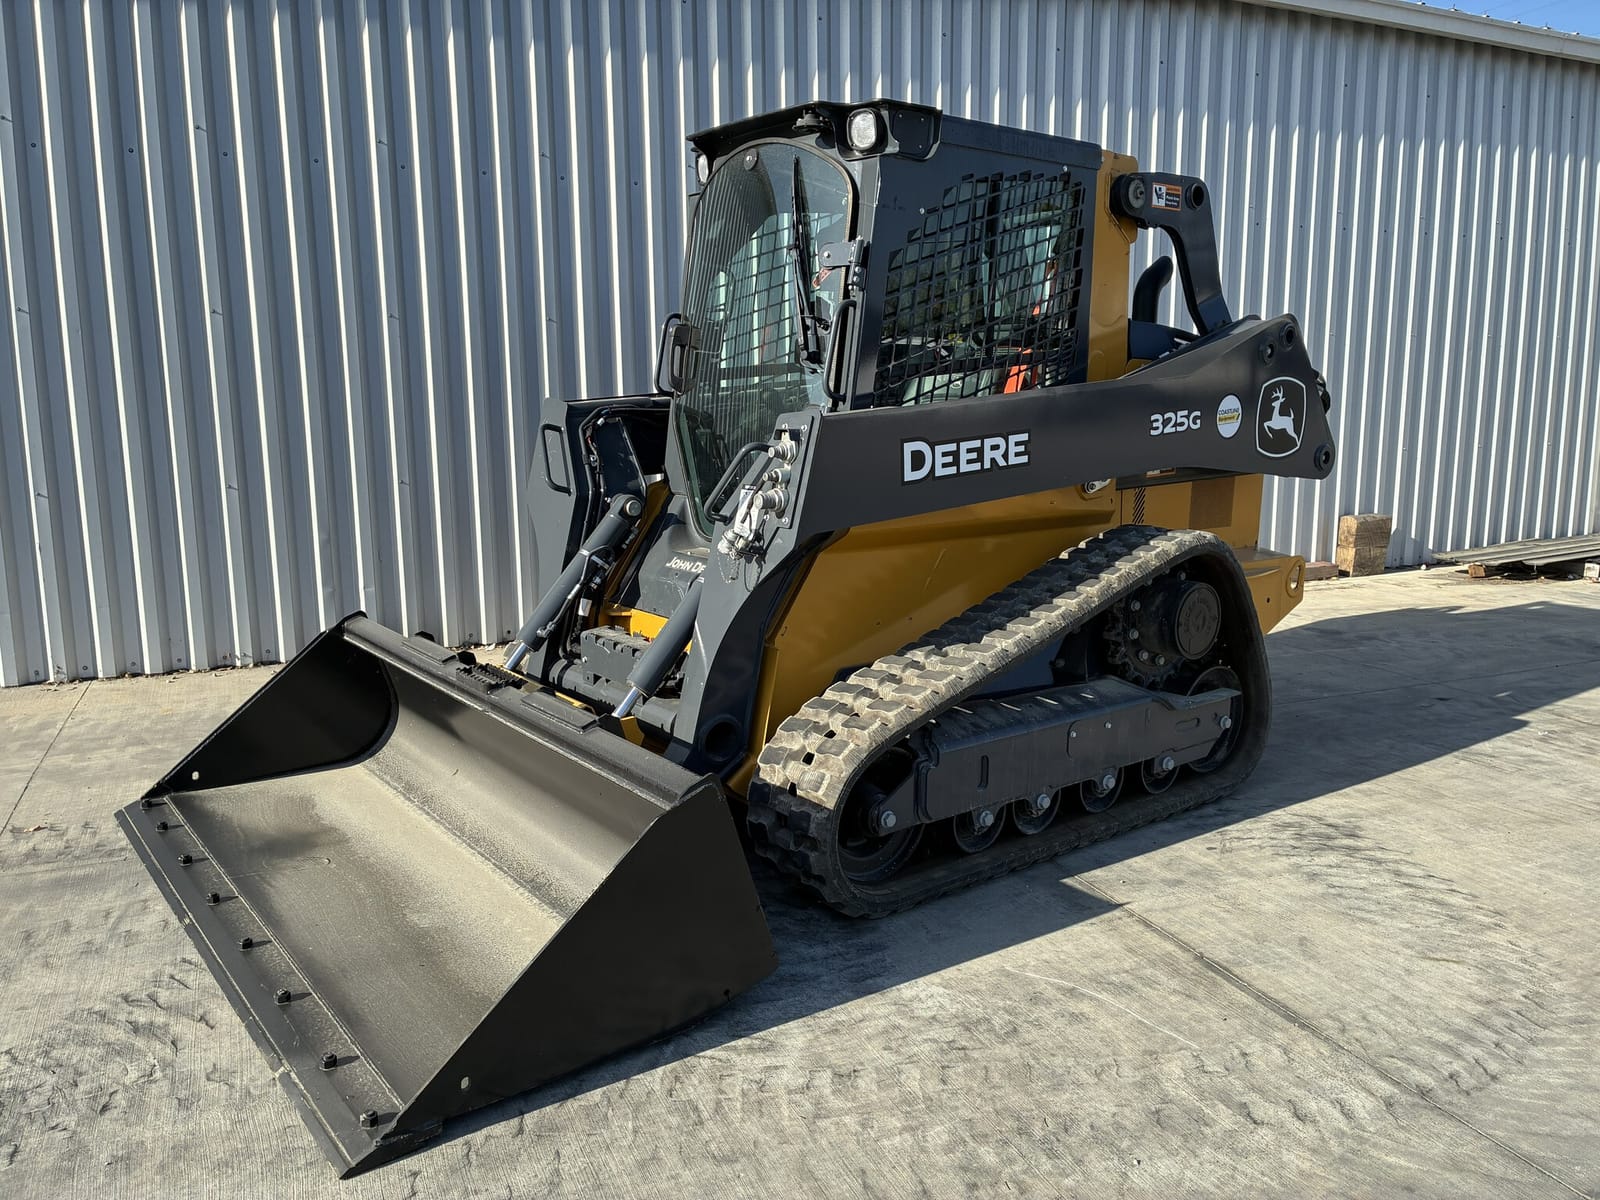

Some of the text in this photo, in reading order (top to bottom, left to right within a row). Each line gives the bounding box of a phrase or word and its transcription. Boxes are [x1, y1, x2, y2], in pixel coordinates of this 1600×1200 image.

[1150, 410, 1201, 436] 325G
[902, 431, 1030, 483] DEERE
[666, 556, 693, 570] JOHN
